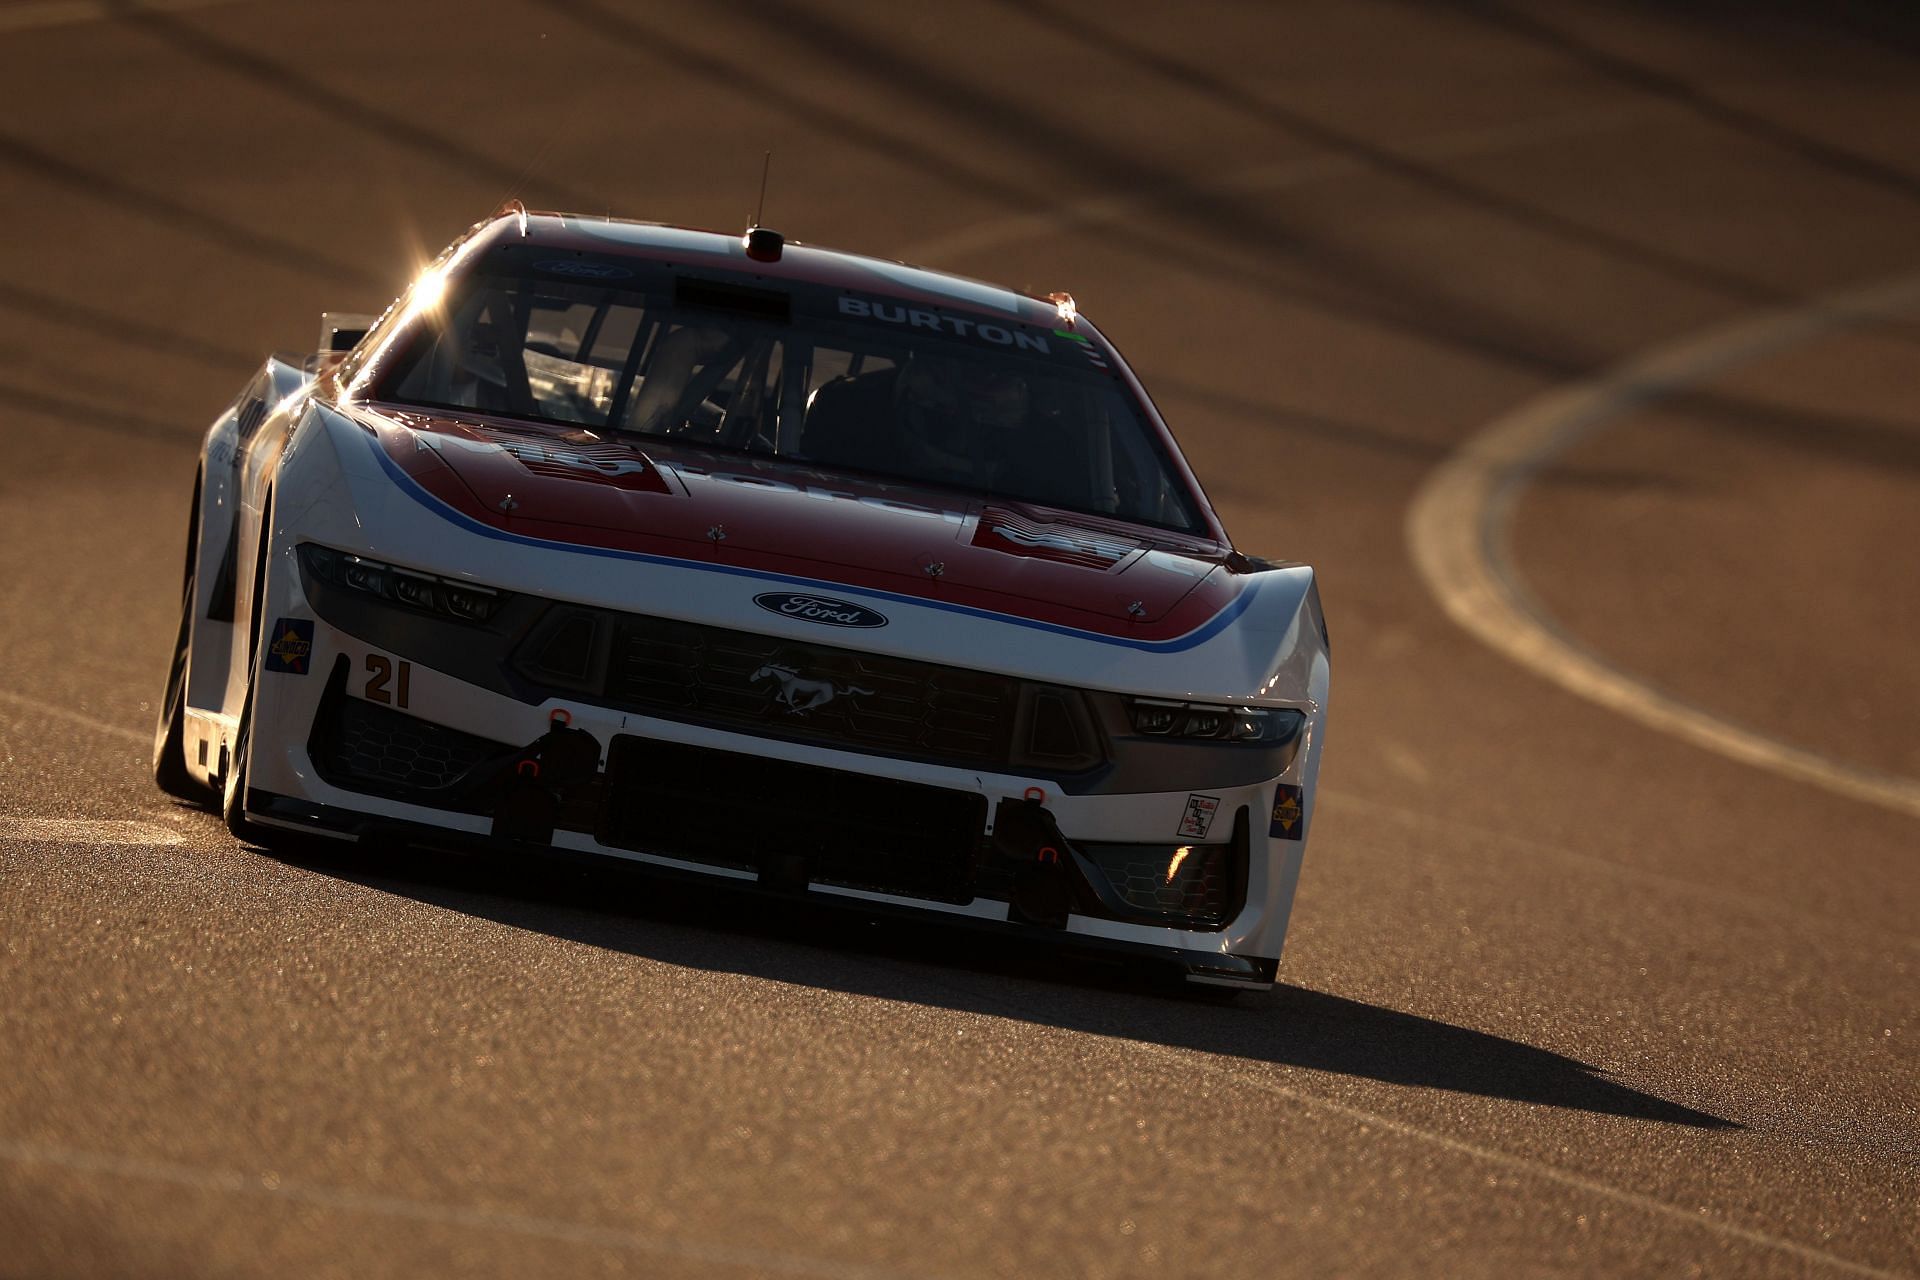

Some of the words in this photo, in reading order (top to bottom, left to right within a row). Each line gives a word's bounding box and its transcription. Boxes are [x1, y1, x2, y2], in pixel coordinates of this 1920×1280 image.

[839, 297, 1051, 354] BURTON
[780, 596, 862, 623] Ford
[366, 653, 411, 709] 21
